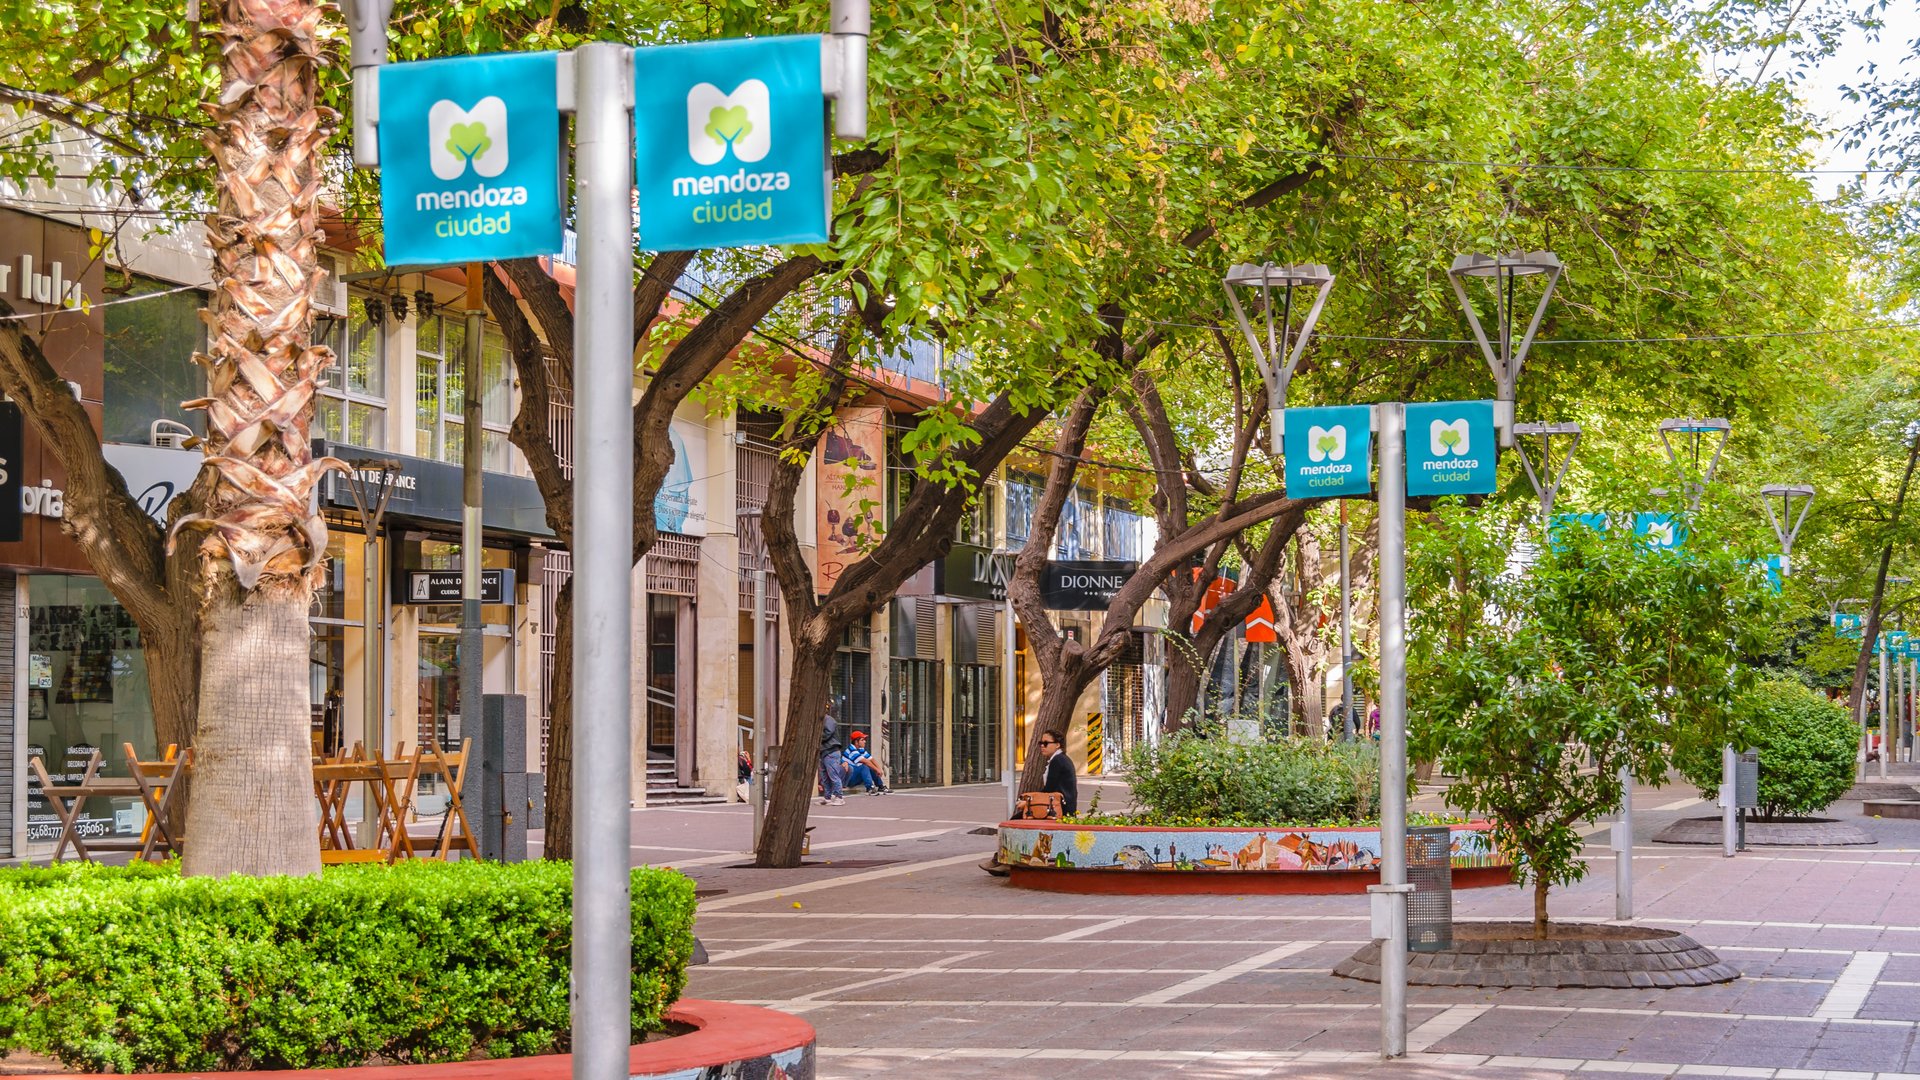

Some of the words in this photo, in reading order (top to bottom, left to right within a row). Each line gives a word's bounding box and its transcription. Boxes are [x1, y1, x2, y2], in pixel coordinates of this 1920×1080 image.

[673, 168, 790, 196] mendoza
[416, 184, 528, 211] mendoza
[692, 197, 773, 223] ciudad
[435, 211, 511, 238] ciudad
[1300, 463, 1352, 476] mendoza
[1423, 458, 1478, 470] mendoza
[1309, 475, 1344, 487] ciudad
[1432, 470, 1470, 483] ciudad
[1061, 575, 1122, 589] DIONNE
